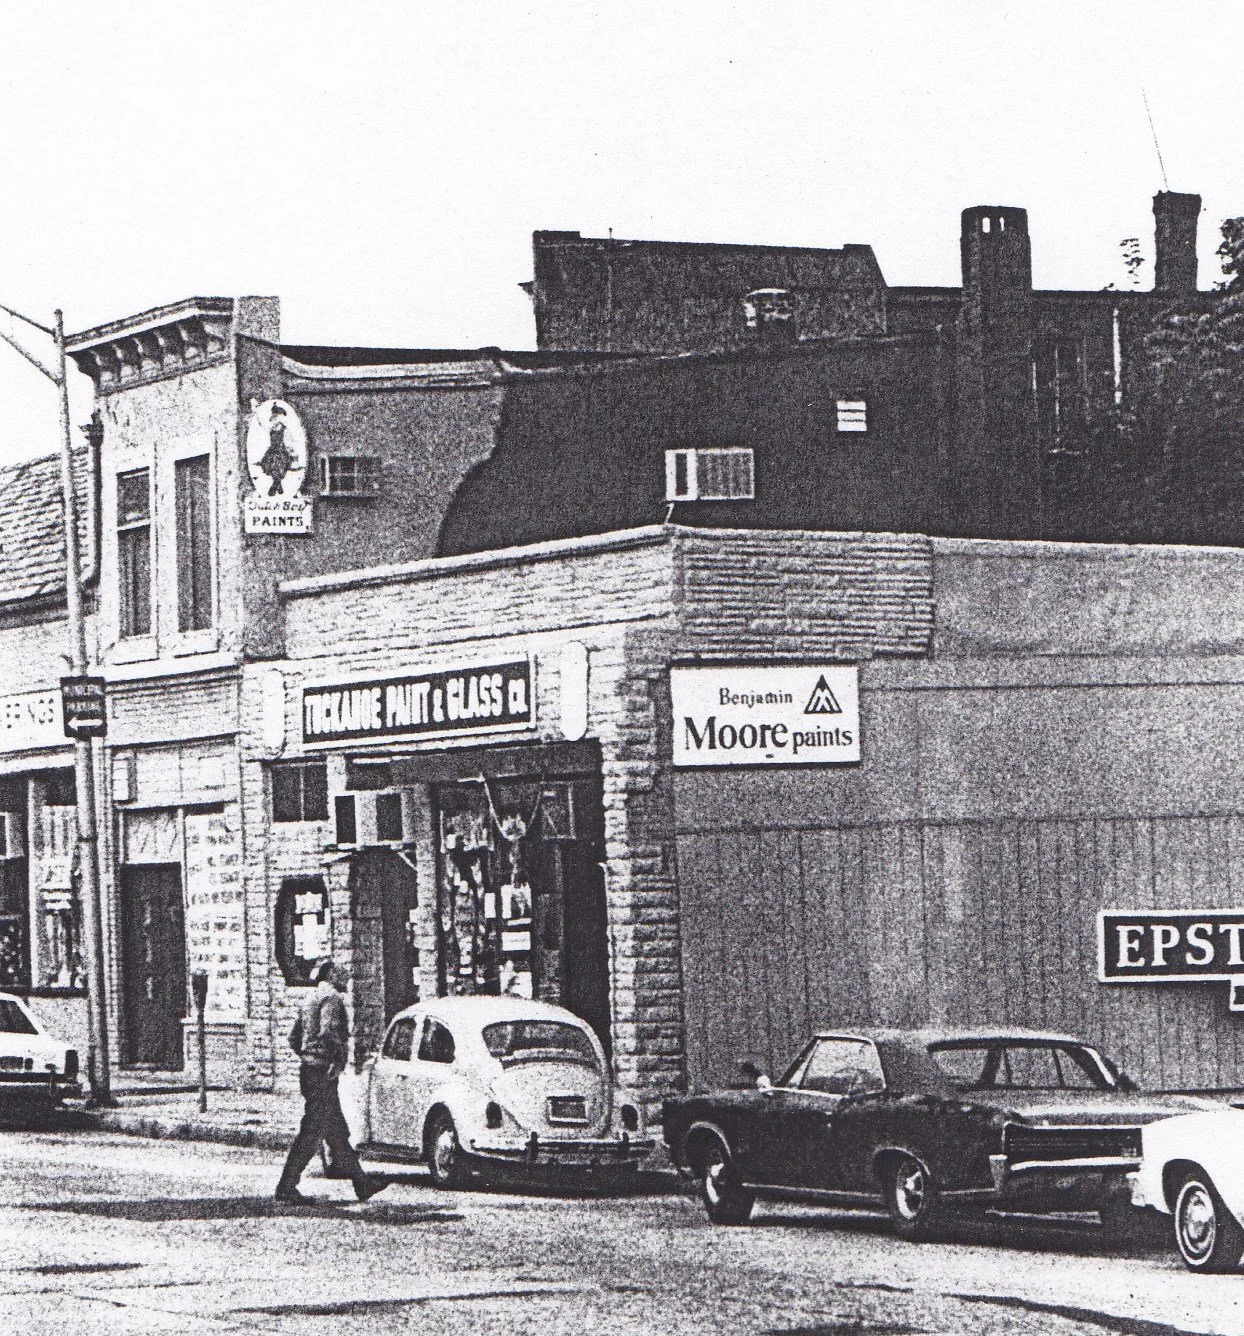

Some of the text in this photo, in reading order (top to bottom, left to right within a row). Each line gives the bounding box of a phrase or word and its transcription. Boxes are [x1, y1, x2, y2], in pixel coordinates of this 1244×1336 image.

[252, 516, 303, 526] PAINTS
[304, 687, 382, 735] TUCKAHOE
[386, 681, 431, 728] PAINT
[433, 689, 445, 722] &
[446, 673, 503, 721] GLASS
[718, 687, 793, 708] Benjamin
[683, 716, 853, 754] Moore paints
